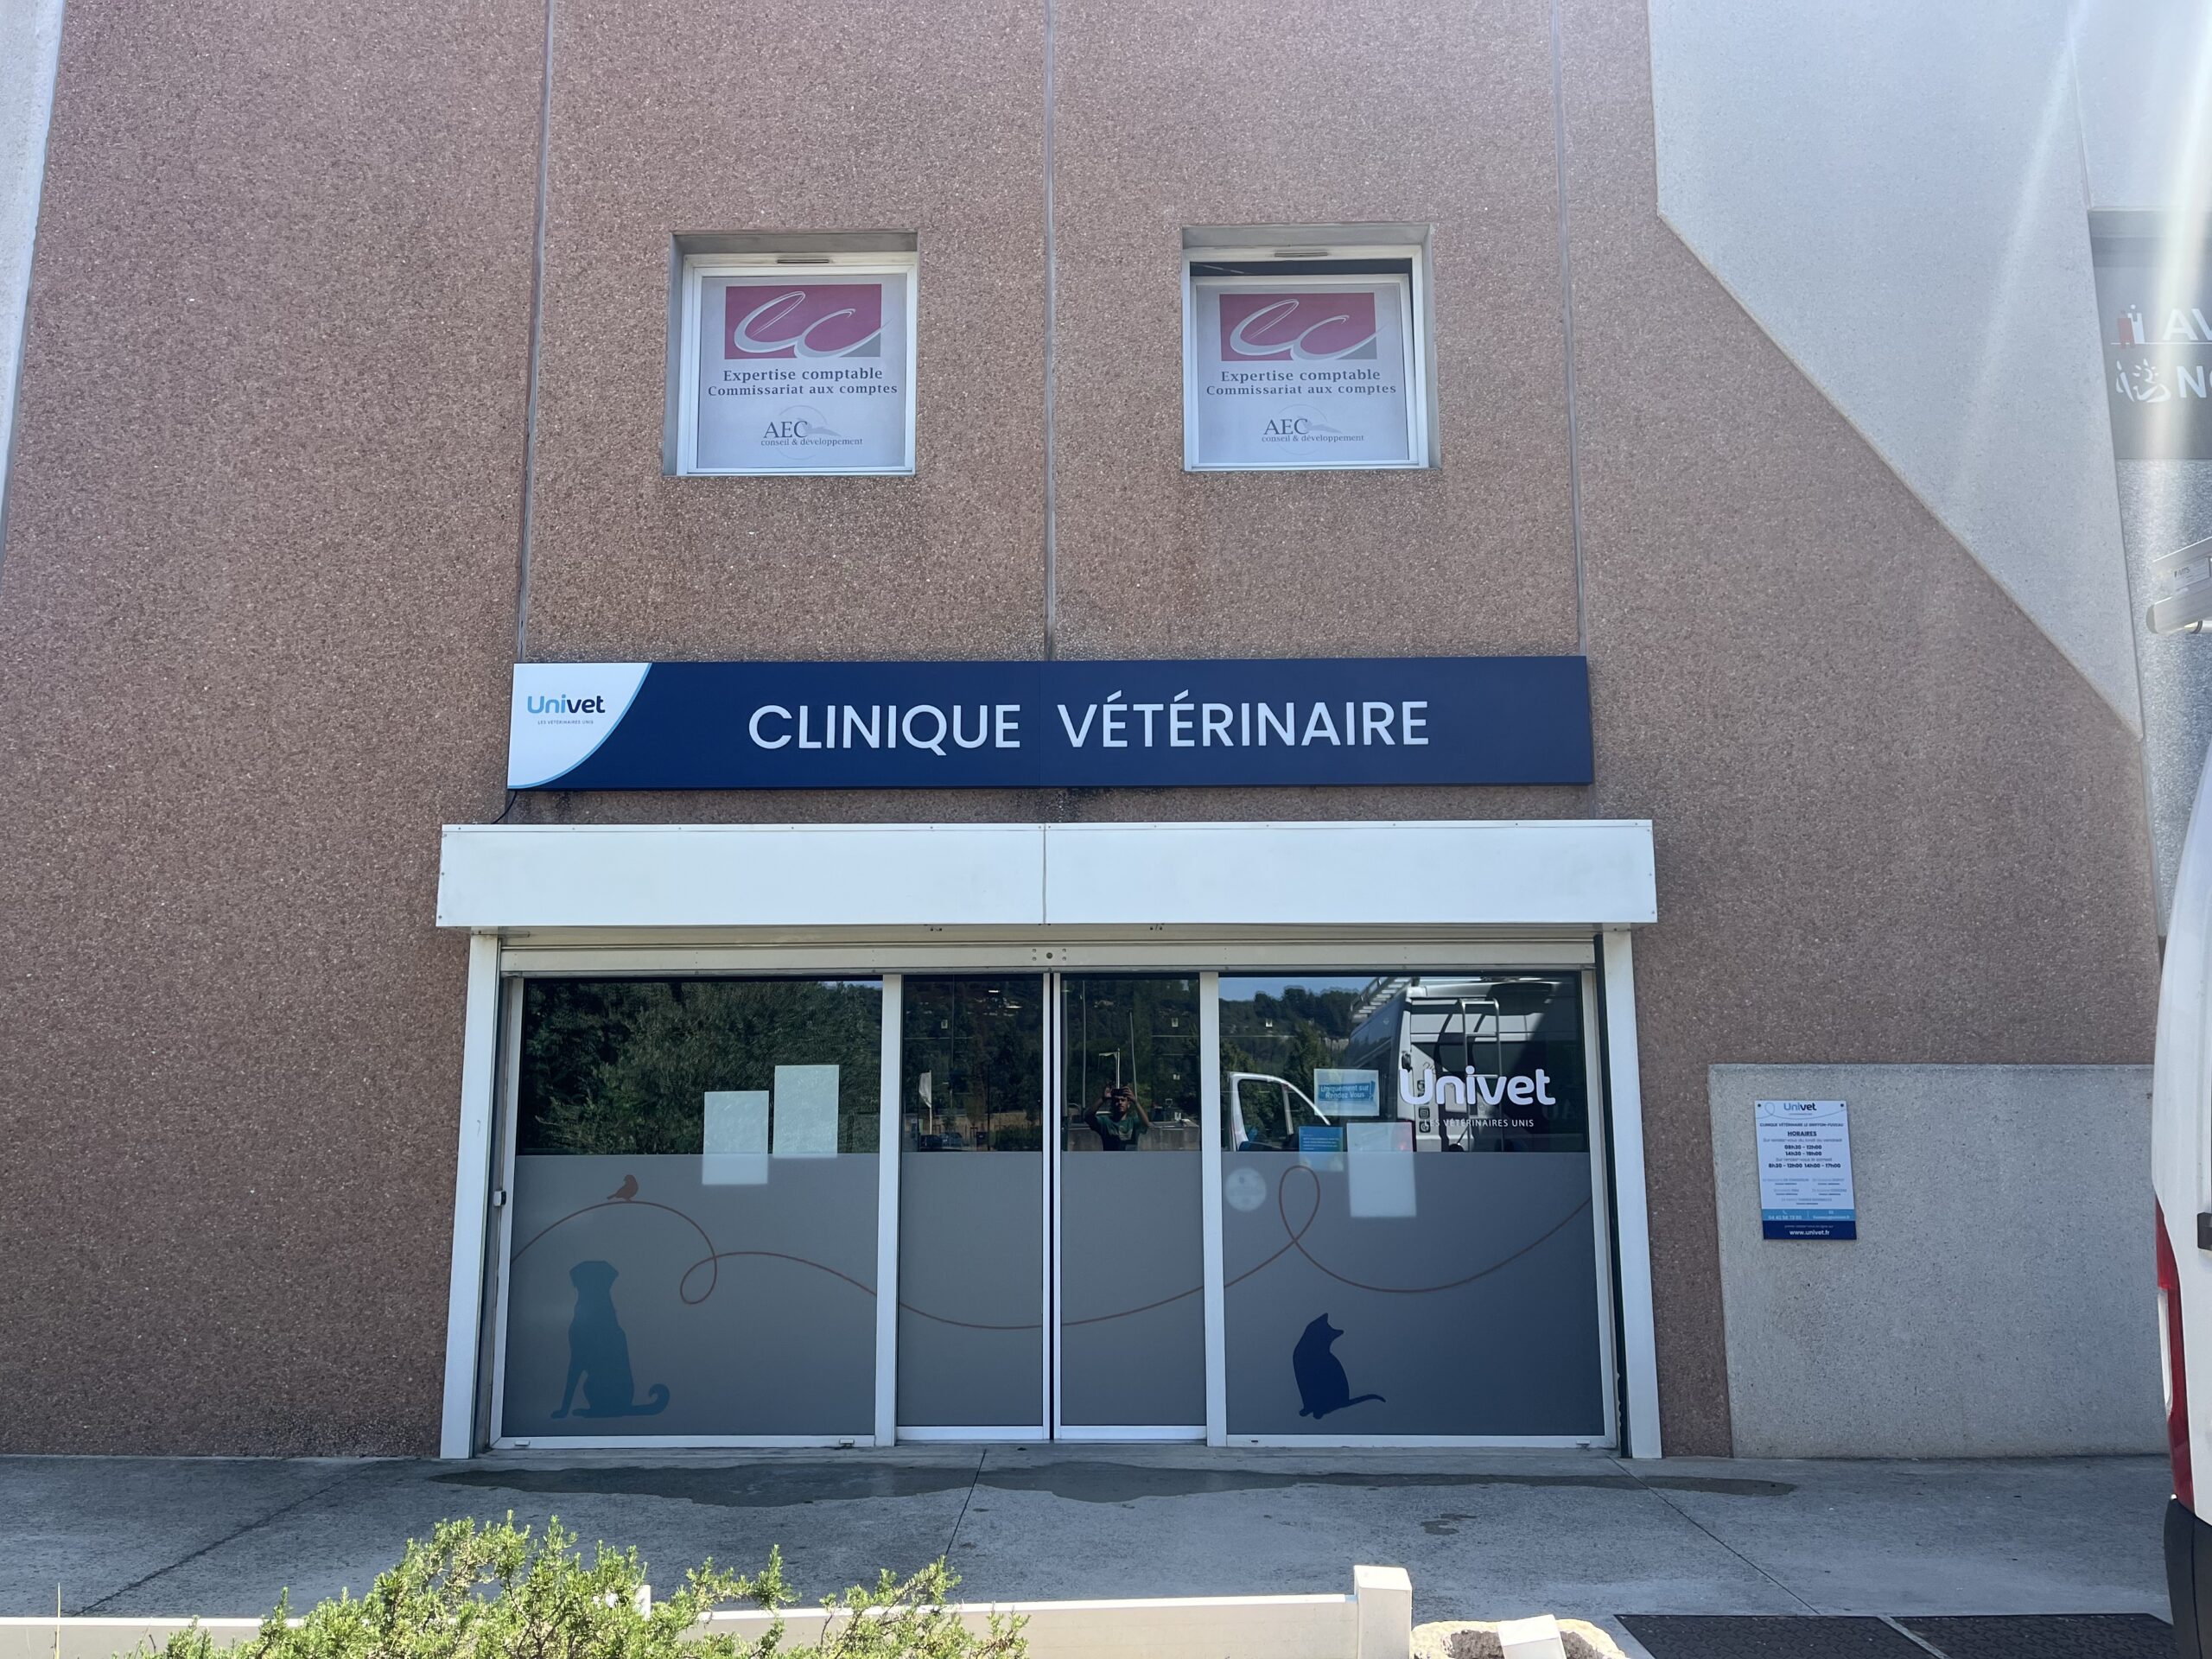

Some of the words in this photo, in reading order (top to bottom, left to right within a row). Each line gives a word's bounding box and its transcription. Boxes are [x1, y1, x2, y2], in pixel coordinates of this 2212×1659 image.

[723, 368, 796, 382] Expertise
[802, 367, 883, 380] comptable
[1221, 370, 1294, 383] Expertise
[1300, 369, 1381, 382] comptable
[2176, 365, 2212, 398] N
[708, 385, 804, 397] Commissariat
[839, 385, 898, 396] comptes
[1206, 385, 1302, 396] Commissariat
[1338, 385, 1396, 395] comptes
[763, 421, 808, 438] AEC
[1263, 418, 1309, 435] AEC
[800, 437, 862, 447] développement
[1300, 434, 1364, 443] développement
[527, 694, 606, 714] Univet
[748, 704, 1020, 756] CLINIQUE
[1057, 690, 1429, 747] VÉTÉRINAIRE
[1399, 1065, 1556, 1105] Univet
[1783, 1102, 1817, 1111] Univet
[1425, 1119, 1440, 1128] LES
[1443, 1117, 1509, 1128] VÉTÉRINAIRES
[1512, 1119, 1534, 1128] UNIS
